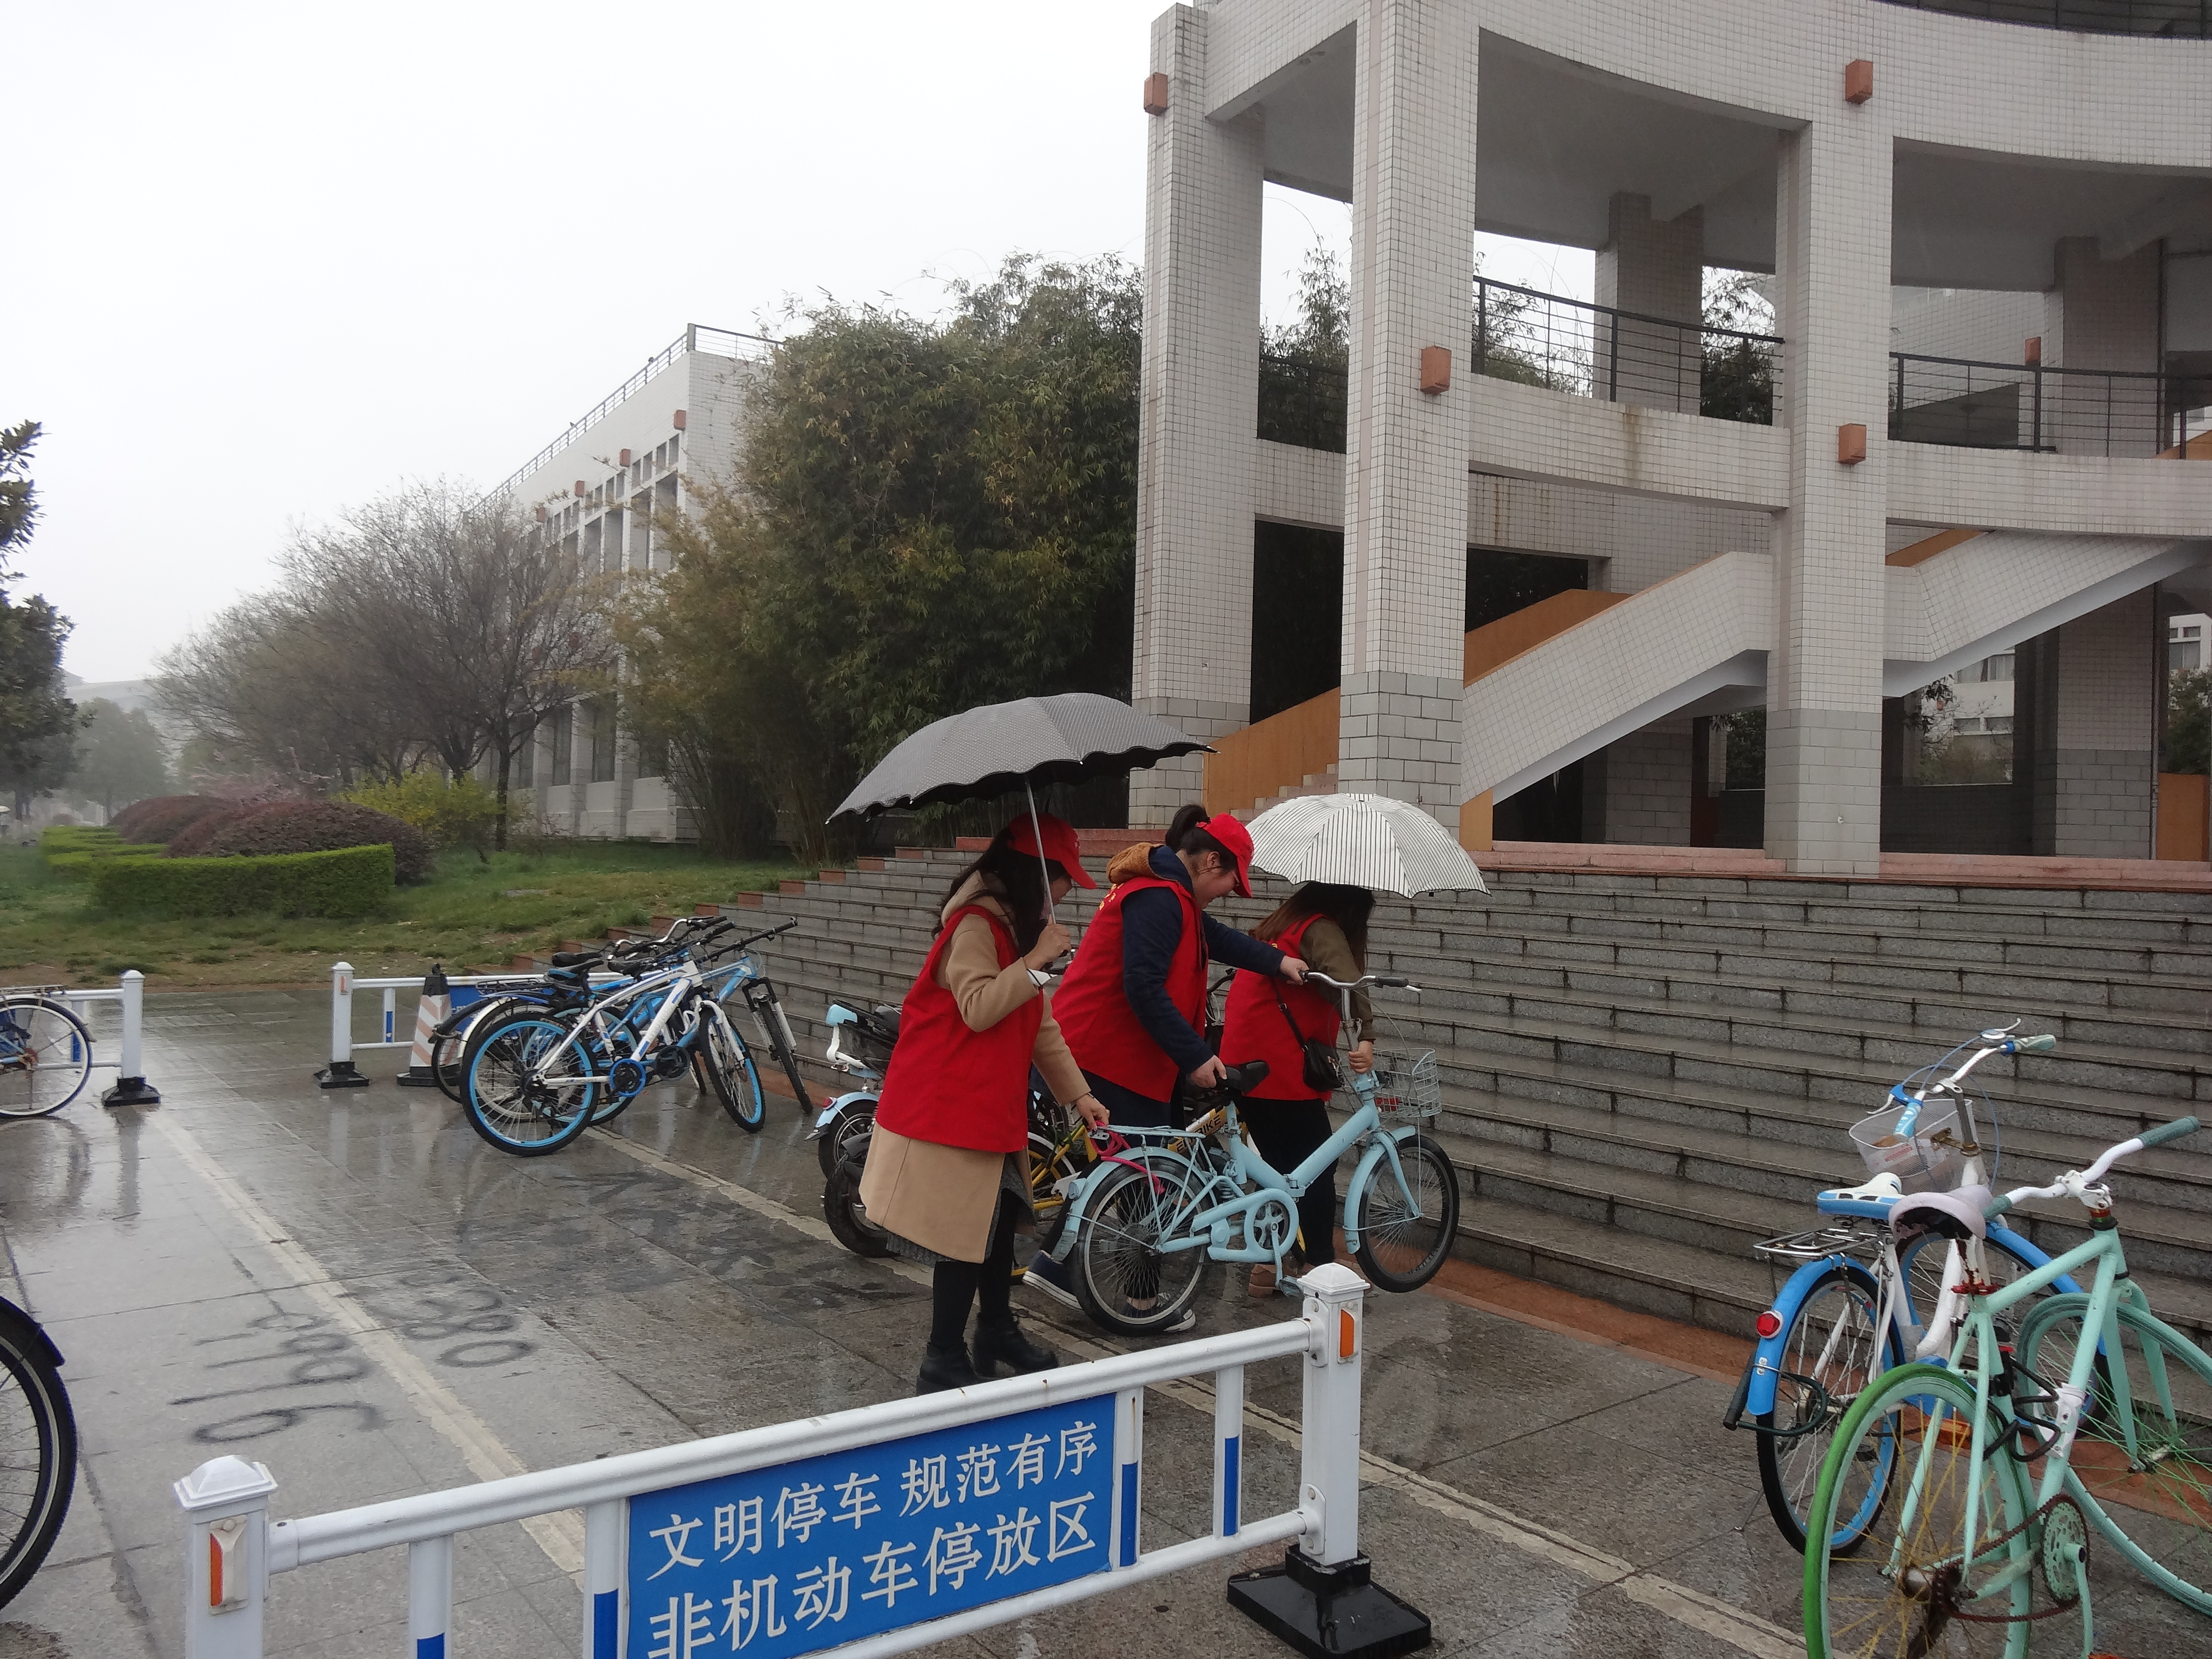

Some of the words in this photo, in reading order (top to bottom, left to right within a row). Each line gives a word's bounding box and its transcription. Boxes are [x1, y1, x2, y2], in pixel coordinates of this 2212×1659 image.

[647, 1472, 881, 1581] 文明停车
[899, 1420, 1098, 1517] 规范有序
[647, 1491, 1096, 1659] 非机动车停放区
